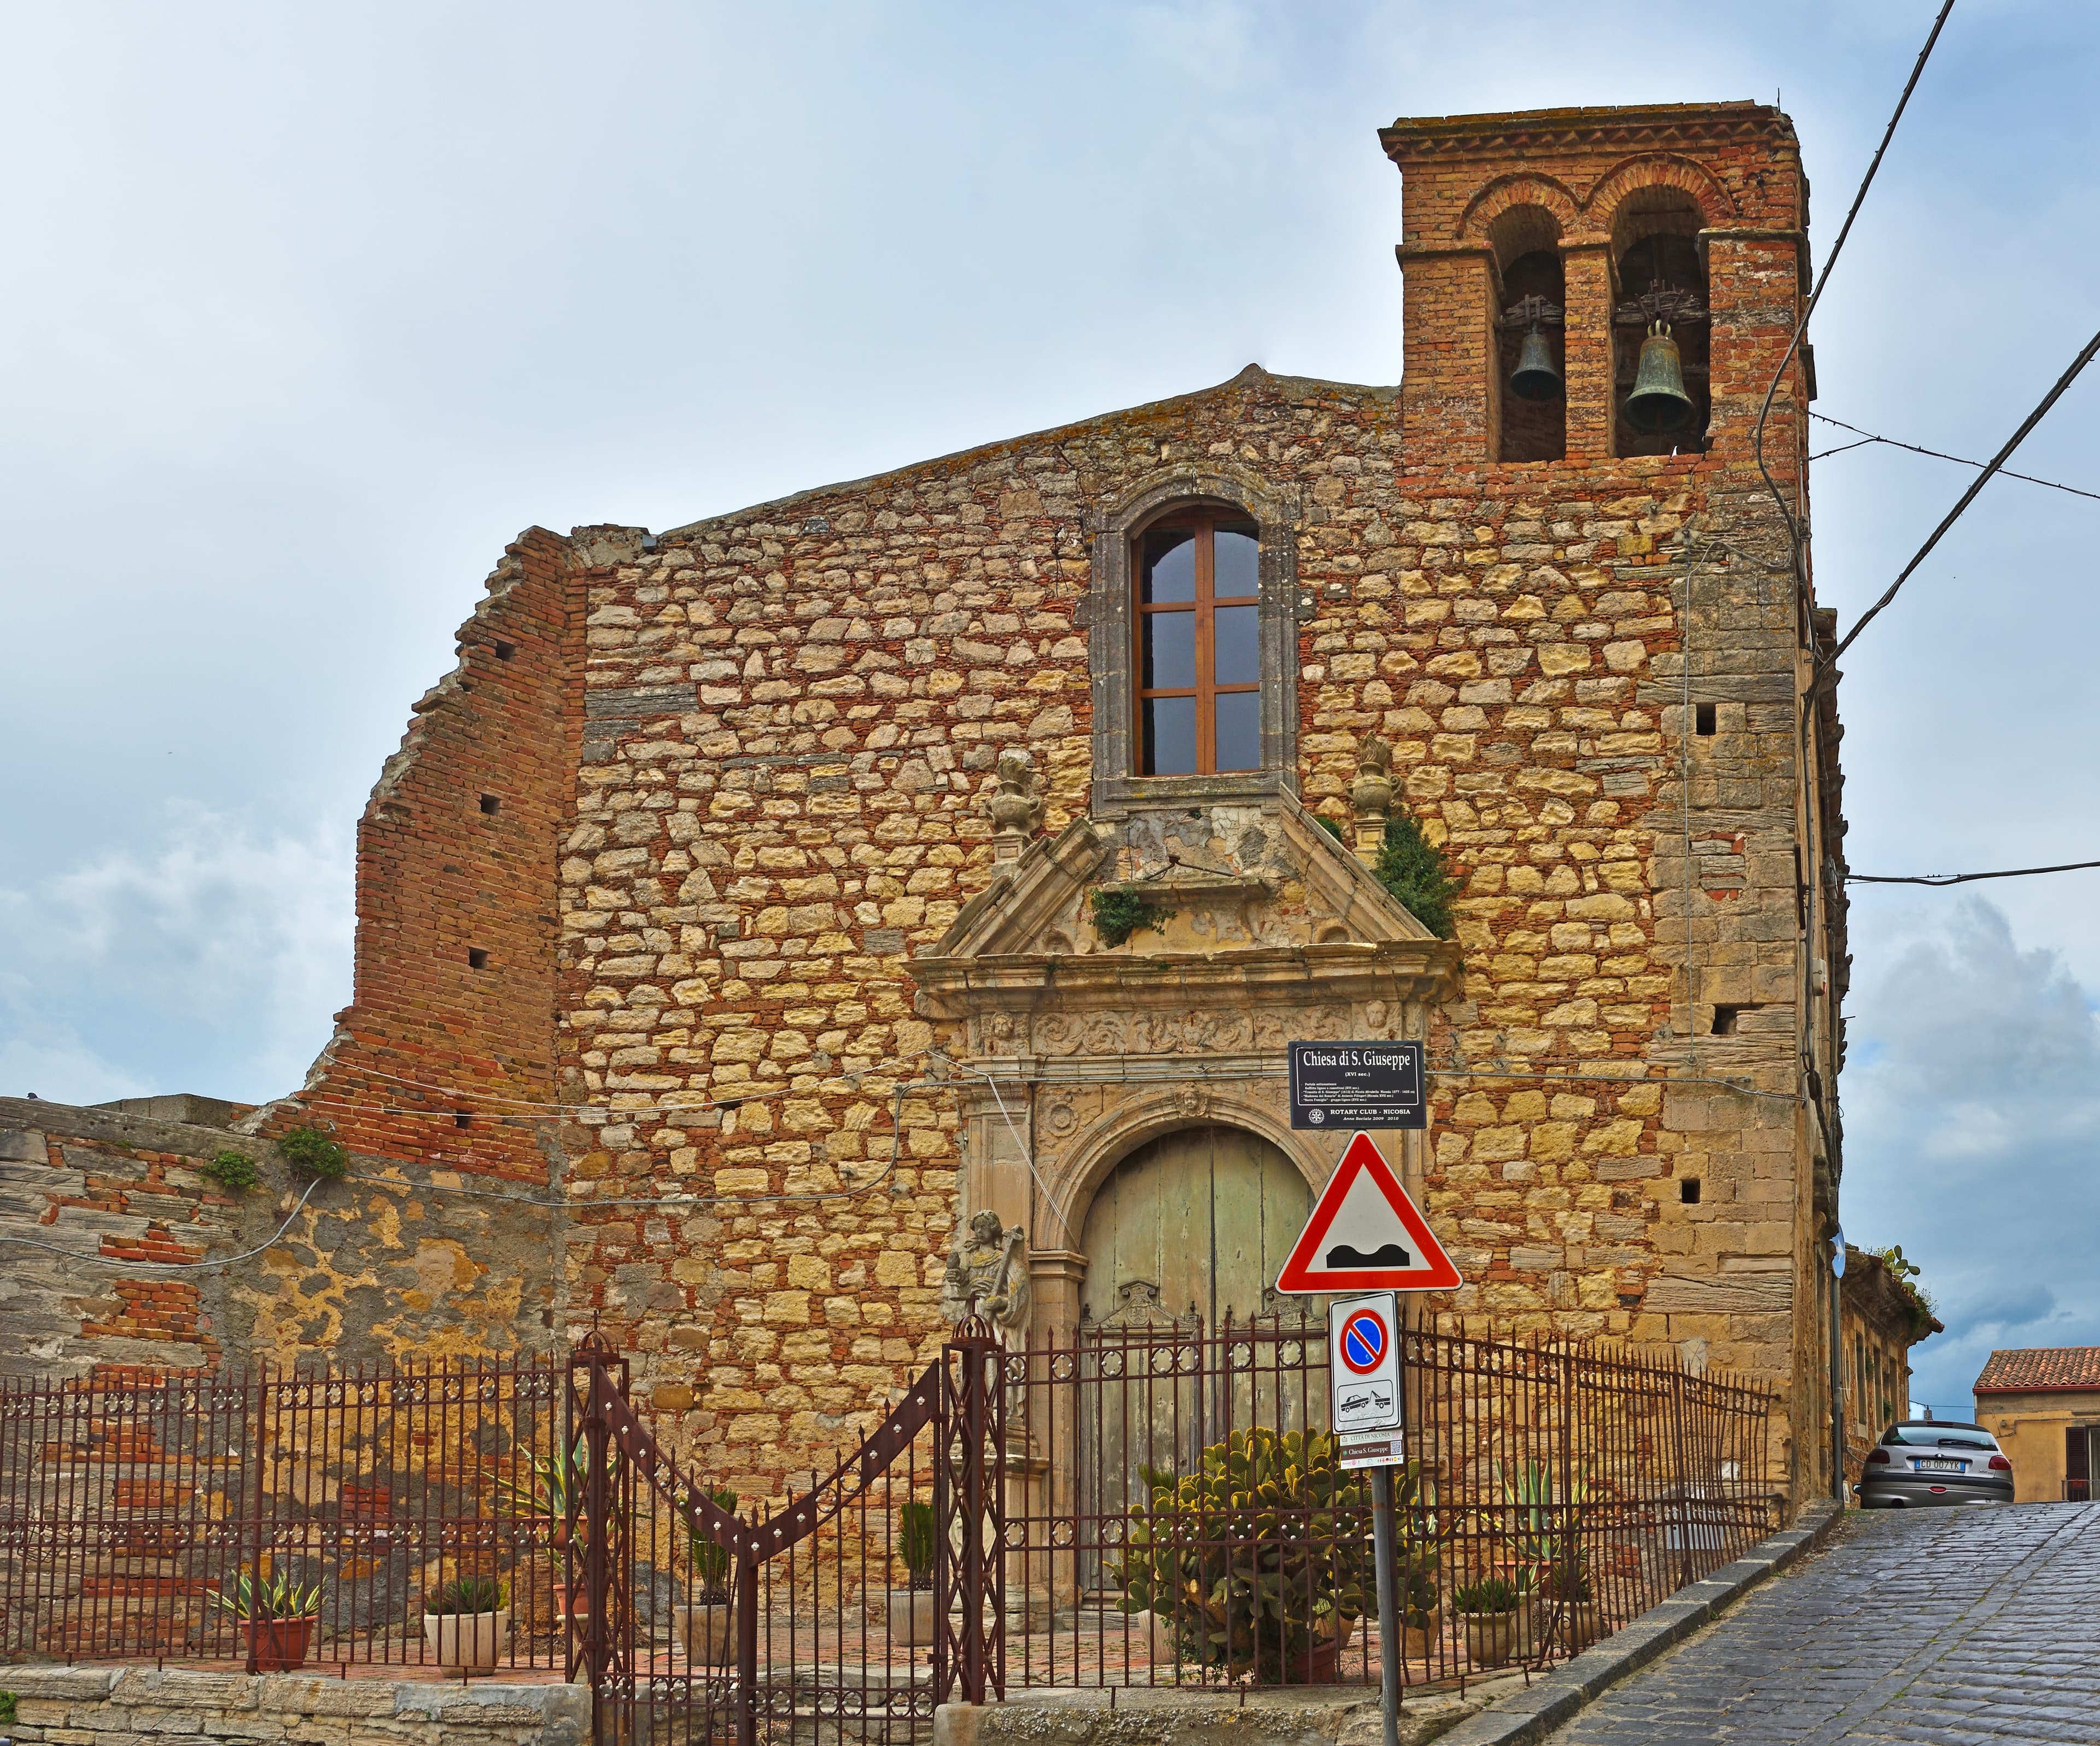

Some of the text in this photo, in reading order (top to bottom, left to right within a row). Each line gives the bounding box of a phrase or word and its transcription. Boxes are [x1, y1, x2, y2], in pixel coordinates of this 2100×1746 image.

[1303, 1051, 1410, 1070] Chiesa di S. Giuseppe
[1934, 1461, 1959, 1469] 007YK
